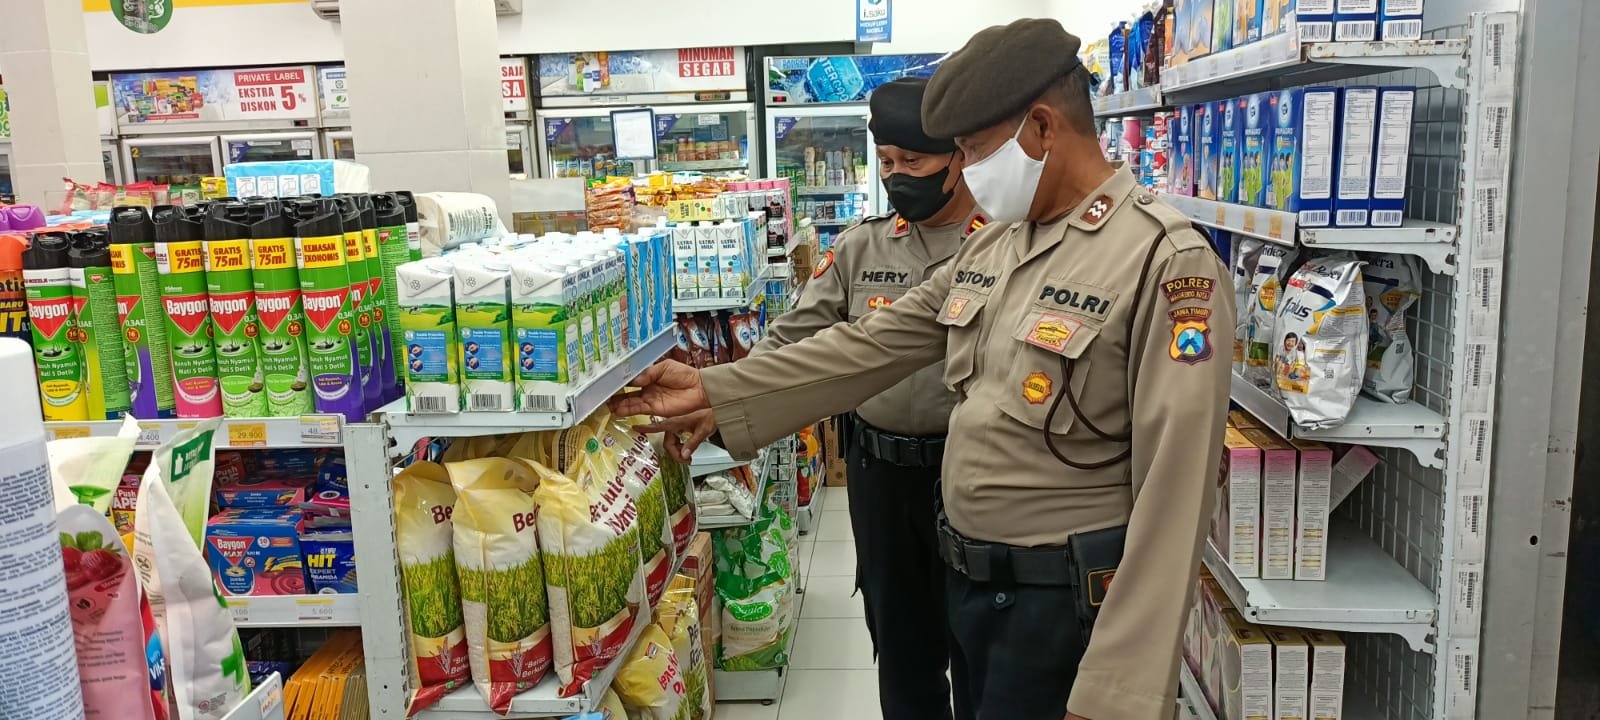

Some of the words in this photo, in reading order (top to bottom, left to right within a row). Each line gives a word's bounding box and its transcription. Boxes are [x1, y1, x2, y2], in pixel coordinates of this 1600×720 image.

[678, 47, 734, 61] MINUMAN
[683, 62, 731, 77] SEGAR
[238, 73, 271, 82] PRIVATE
[274, 72, 300, 81] LABEL
[238, 87, 275, 99] EKSTRA
[240, 100, 277, 112] DISKON
[175, 248, 202, 257] GRATIS
[213, 246, 241, 255] GRATIS
[257, 244, 285, 254] GRATIS
[303, 242, 337, 252] KEMASAN
[176, 256, 204, 269] 75ml
[214, 254, 243, 268] 75ml
[259, 254, 287, 266] 75ml
[304, 252, 340, 263] EKONOMIS
[861, 270, 908, 284] HERY
[1166, 278, 1210, 293] POLRES
[302, 294, 342, 312] Baygon
[1038, 285, 1110, 315] POLRI
[166, 299, 208, 317] Baygon
[210, 298, 248, 315] Baygon
[1173, 309, 1189, 318] JAWA
[1190, 308, 1209, 317] TIMUR
[340, 323, 349, 331] 16
[430, 504, 455, 525] Be
[217, 539, 246, 551] Baygon
[307, 555, 337, 568] HIT
